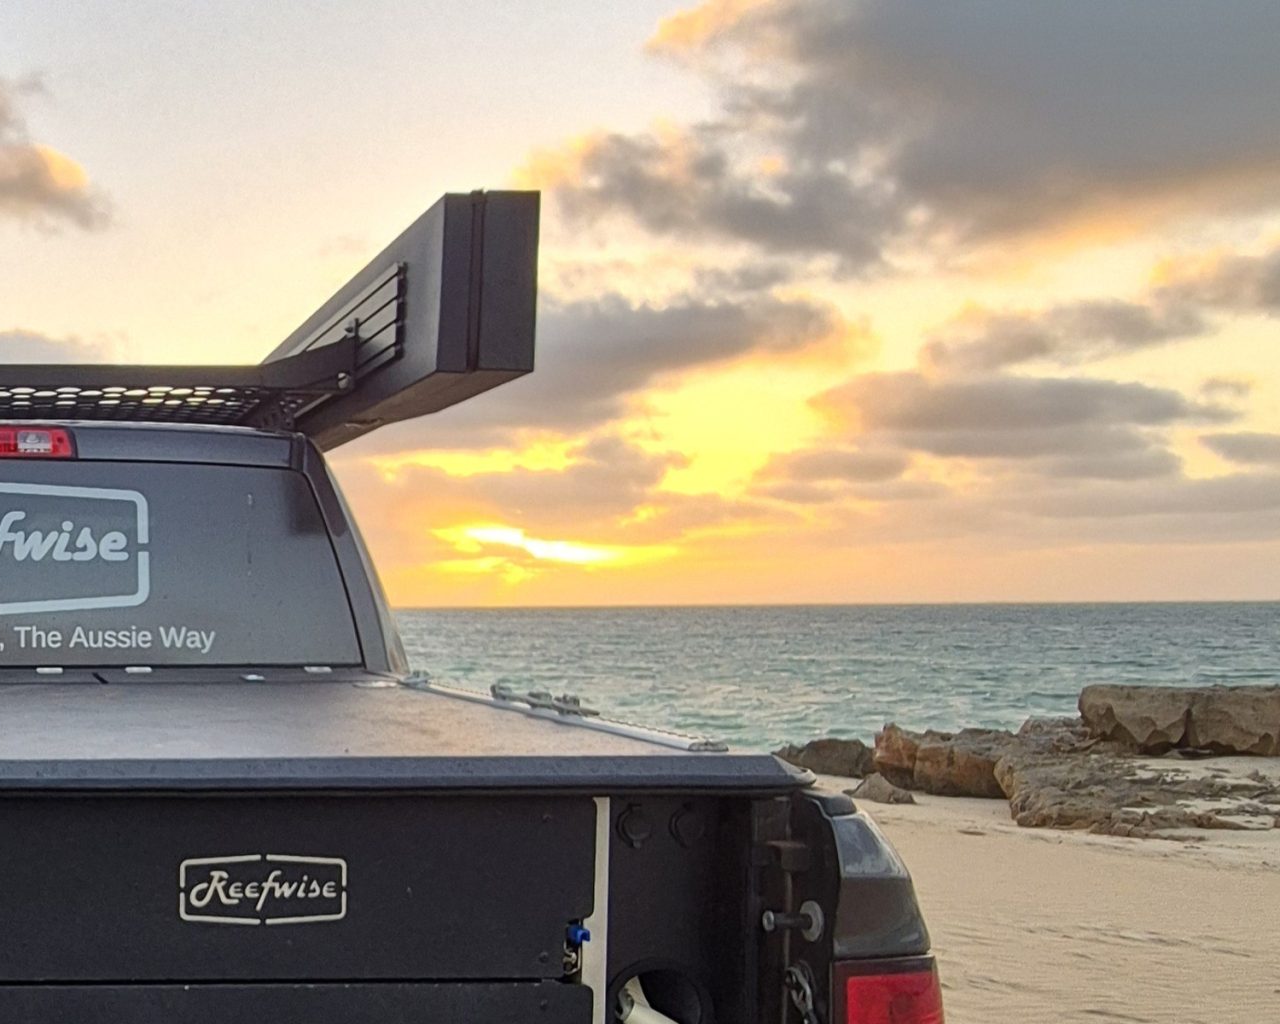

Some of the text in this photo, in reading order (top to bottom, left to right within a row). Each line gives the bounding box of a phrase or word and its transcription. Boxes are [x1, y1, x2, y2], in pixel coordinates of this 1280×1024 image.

[13, 625, 62, 648] The
[69, 625, 152, 648] Aussie
[158, 626, 216, 654] Way
[189, 870, 338, 911] Reefwise
